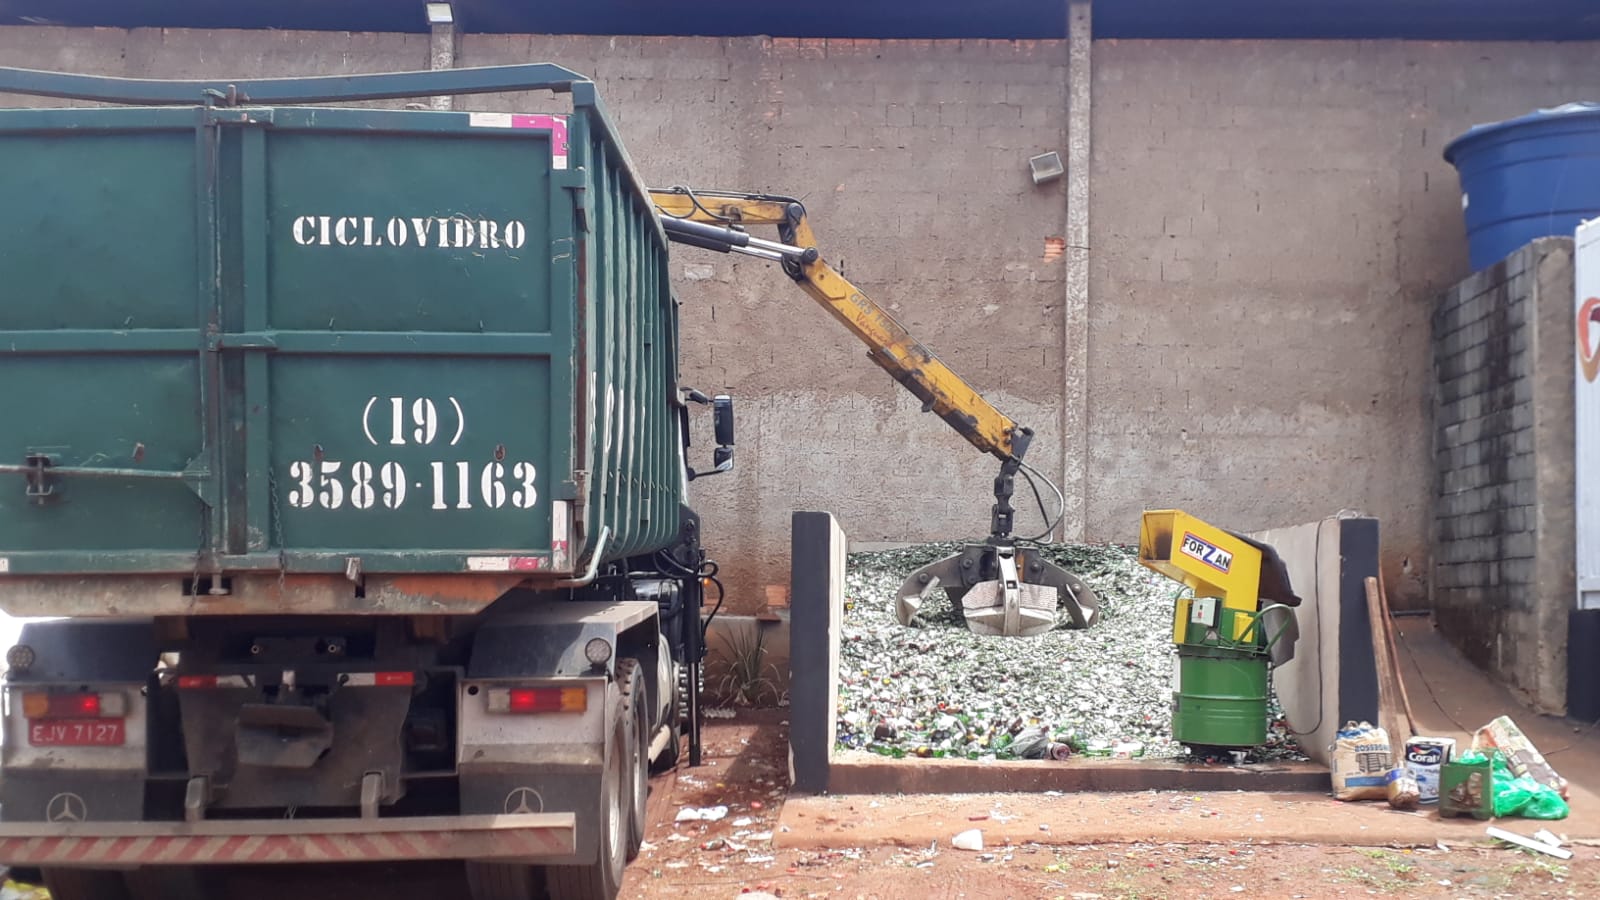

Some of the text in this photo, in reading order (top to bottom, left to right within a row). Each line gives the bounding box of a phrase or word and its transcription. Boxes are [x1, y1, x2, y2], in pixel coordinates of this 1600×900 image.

[292, 215, 526, 249] CICLOVIDRO
[362, 396, 465, 446] (19)
[1183, 537, 1231, 569] FORZAN
[33, 725, 118, 741] EJV 7127
[1409, 752, 1436, 763] Coral
